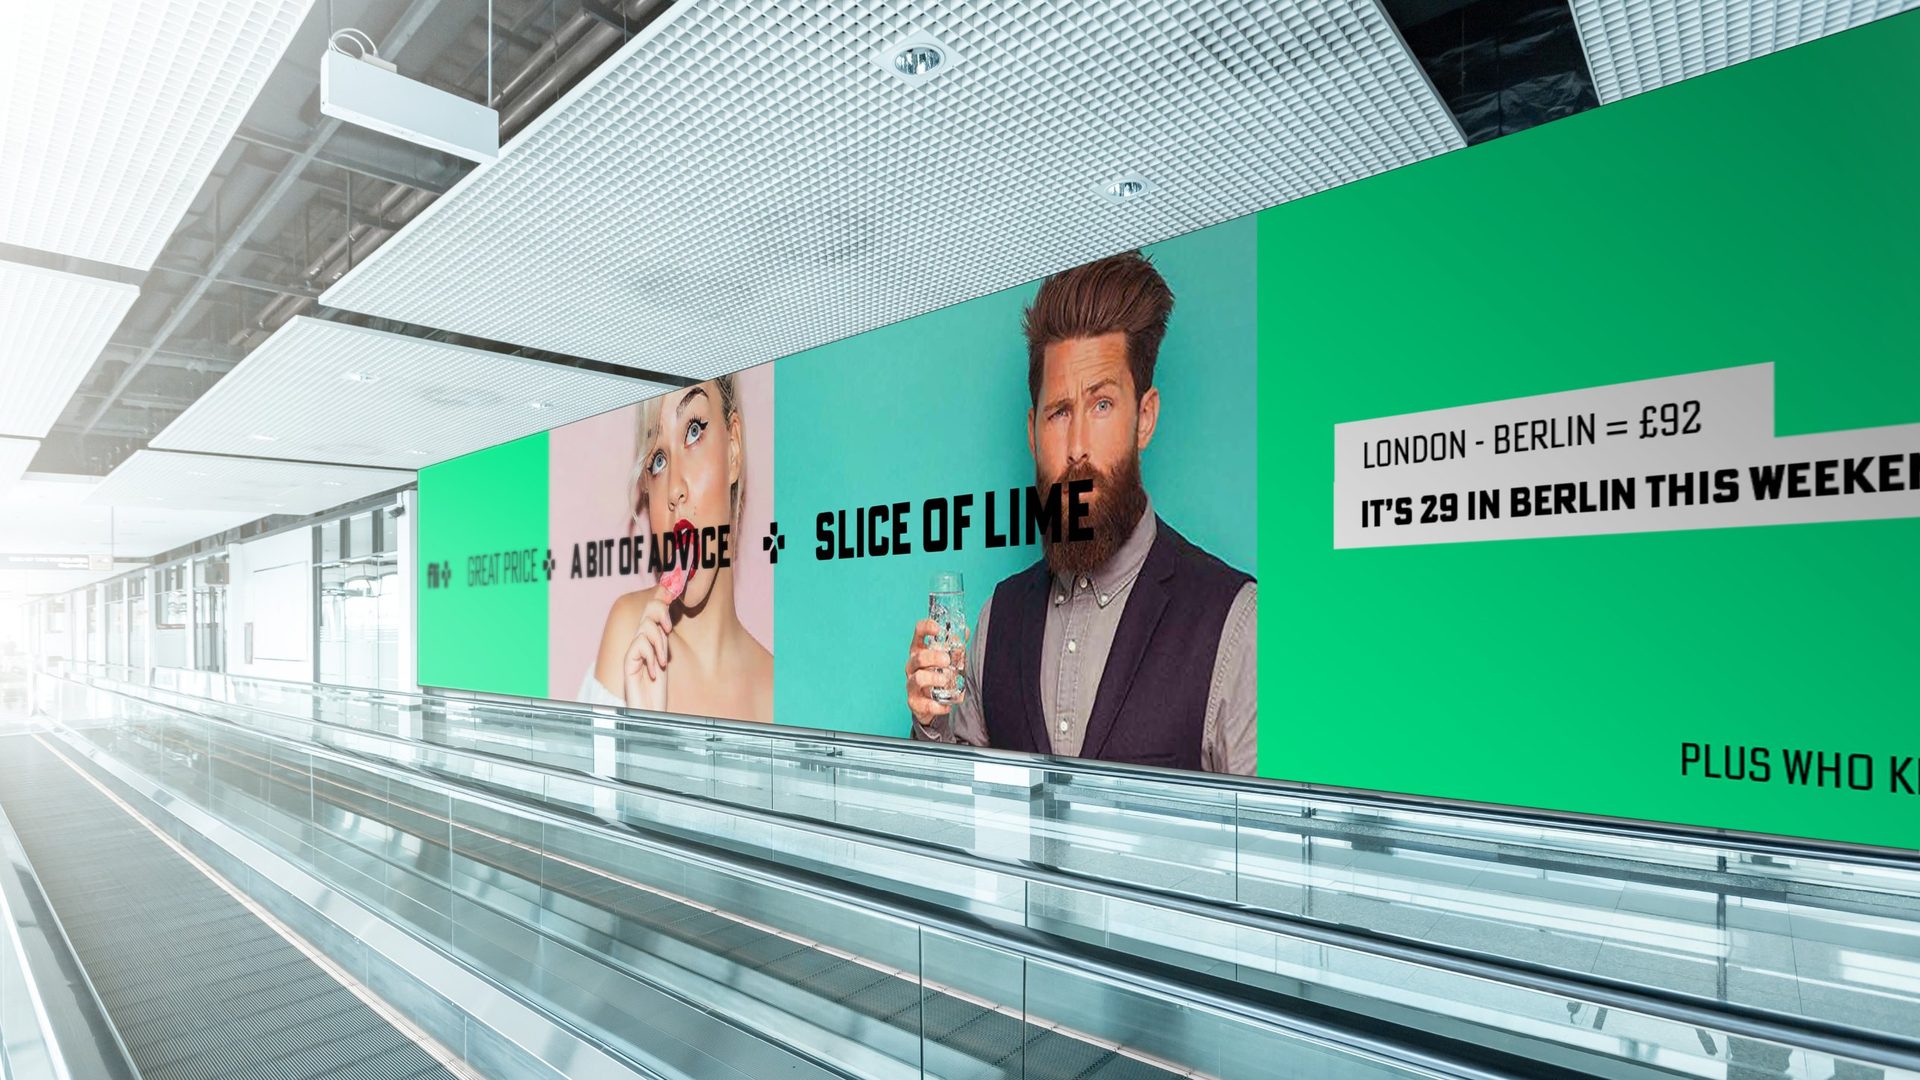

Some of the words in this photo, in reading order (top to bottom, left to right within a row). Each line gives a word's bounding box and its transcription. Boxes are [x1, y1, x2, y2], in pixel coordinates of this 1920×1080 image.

[1363, 429, 1466, 469] LONDON
[1494, 413, 1595, 455] BERLIN
[1639, 400, 1702, 440] £92
[815, 501, 911, 561] SLICE
[923, 493, 974, 553] OF
[985, 479, 1095, 548] LIME
[1361, 496, 1413, 528] IT'S
[1420, 492, 1458, 524] 29
[1468, 488, 1500, 521] IN
[1510, 477, 1636, 518] BERLIN
[1645, 468, 1740, 508] THIS
[467, 552, 501, 587] GREAT
[503, 548, 538, 583] PRICE
[570, 543, 582, 579] A
[586, 538, 615, 578] BIT
[618, 535, 644, 576] OF
[647, 525, 731, 574] ADVICE
[1681, 742, 1771, 782] PLUS
[1782, 749, 1873, 791] WHO
[1890, 756, 1920, 795] K
